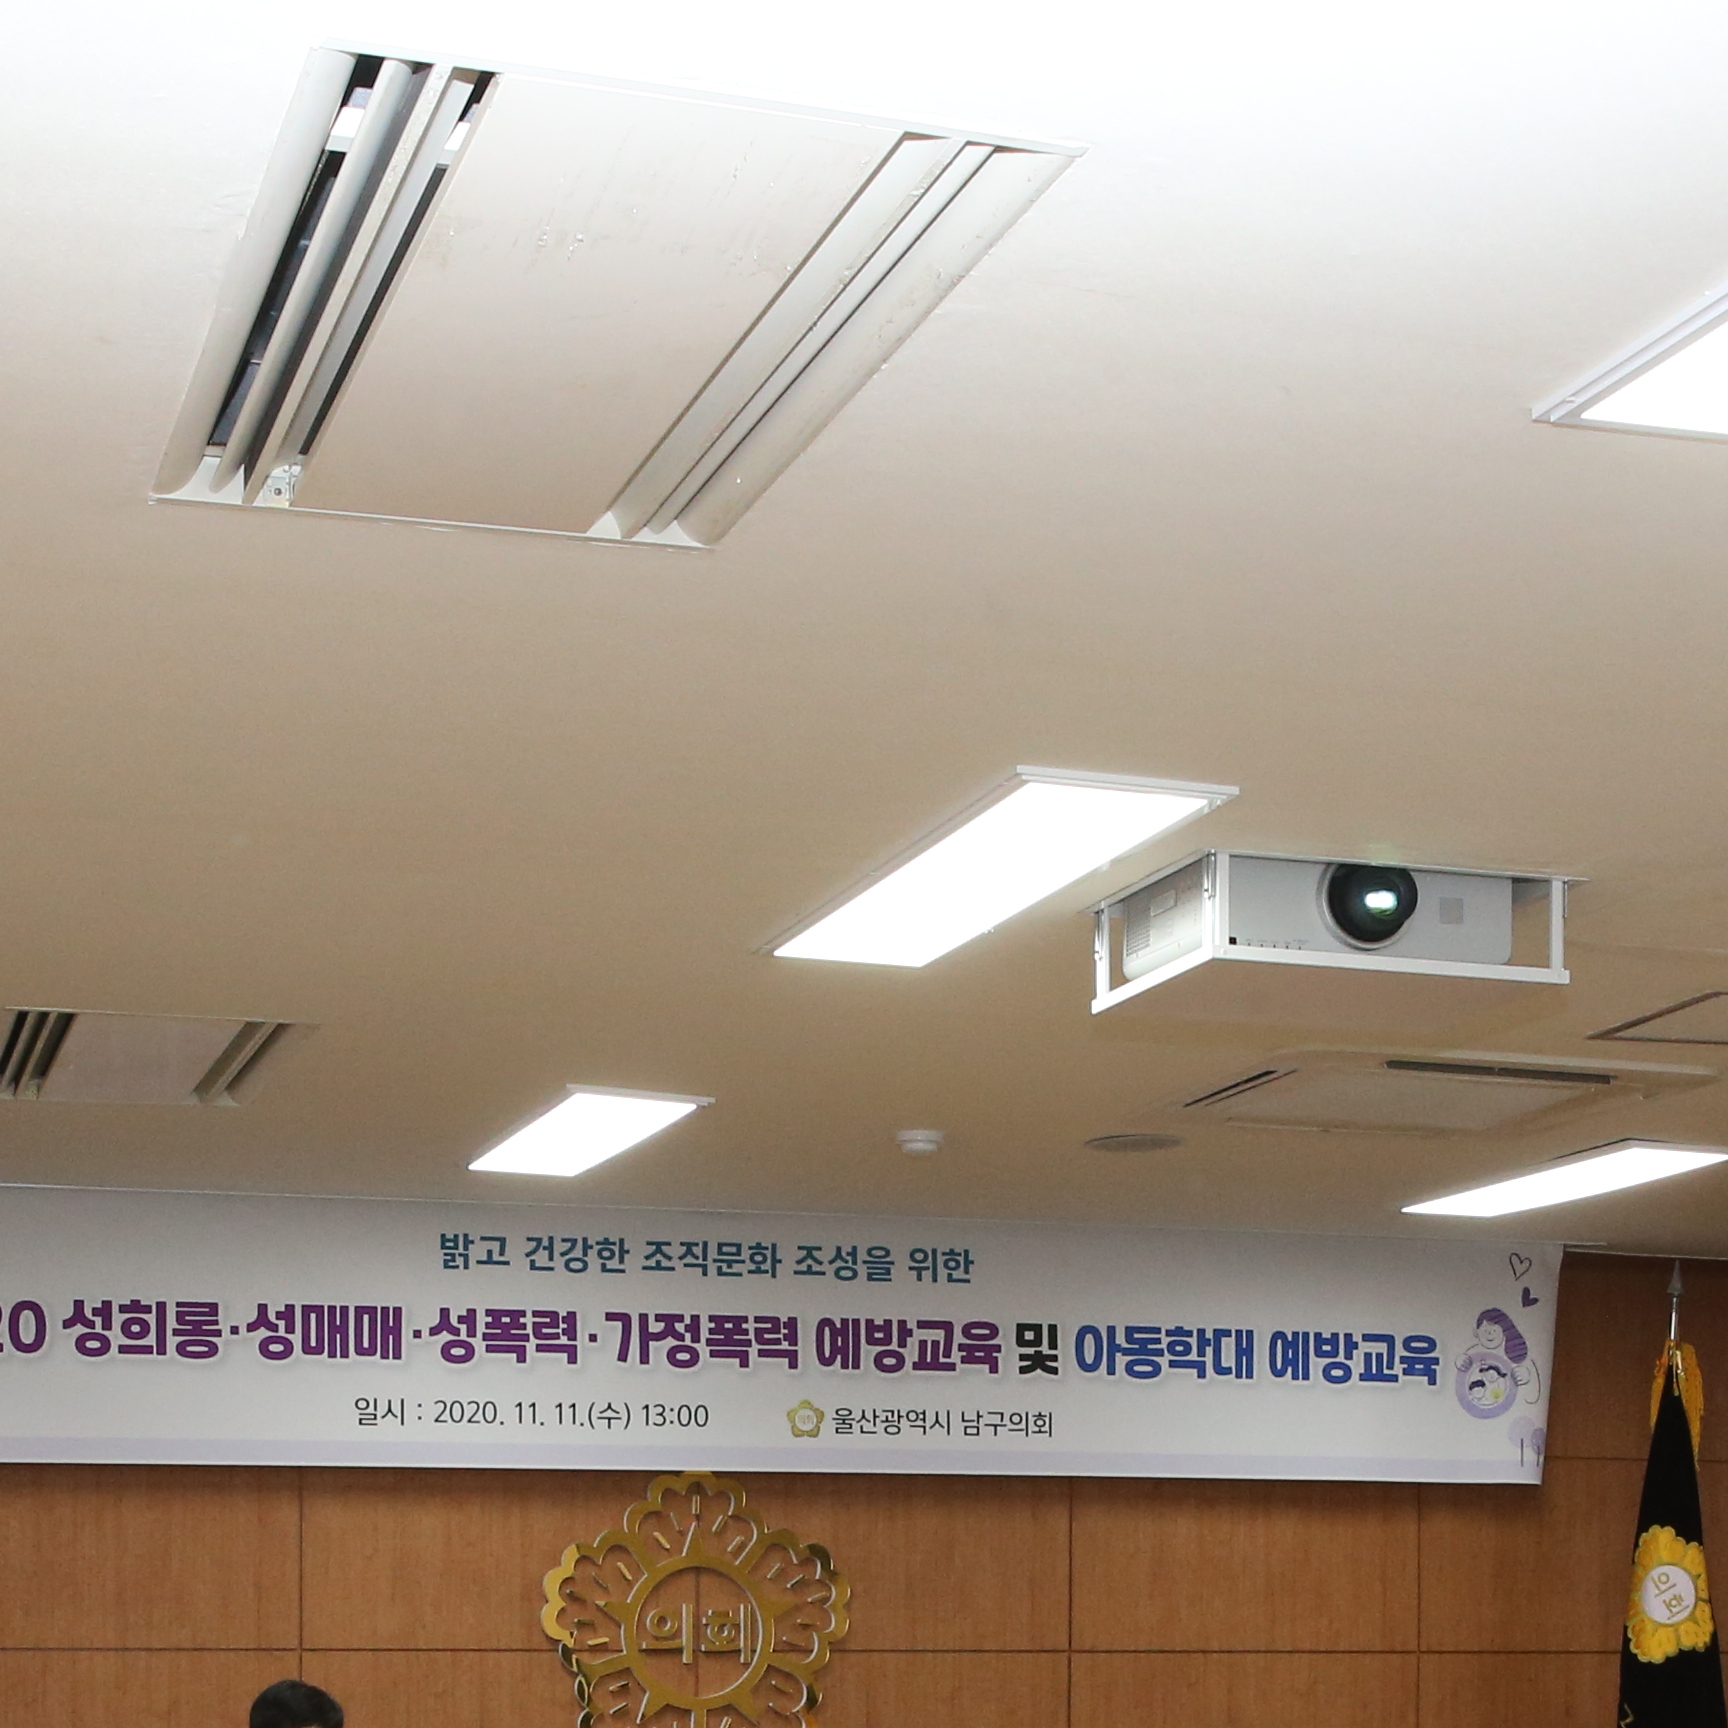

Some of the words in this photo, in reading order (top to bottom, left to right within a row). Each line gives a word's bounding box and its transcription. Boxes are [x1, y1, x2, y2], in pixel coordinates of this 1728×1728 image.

[440, 1231, 510, 1270] 밝고
[525, 1235, 630, 1273] 건강한
[642, 1240, 782, 1278] 조직문화
[794, 1246, 895, 1281] 조성을
[908, 1248, 974, 1283] 위한
[815, 1317, 1001, 1374] 예방교육
[1016, 1323, 1059, 1376] 및
[1075, 1325, 1254, 1381] 아동학대
[1269, 1329, 1440, 1387] 예방교육
[355, 1398, 404, 1427] 일시
[433, 1399, 504, 1426] 2020.
[642, 1404, 708, 1428] 13:00
[832, 1408, 951, 1436] 울산광역시
[961, 1410, 1053, 1437] 남구의회
[642, 1602, 752, 1664] 의회
